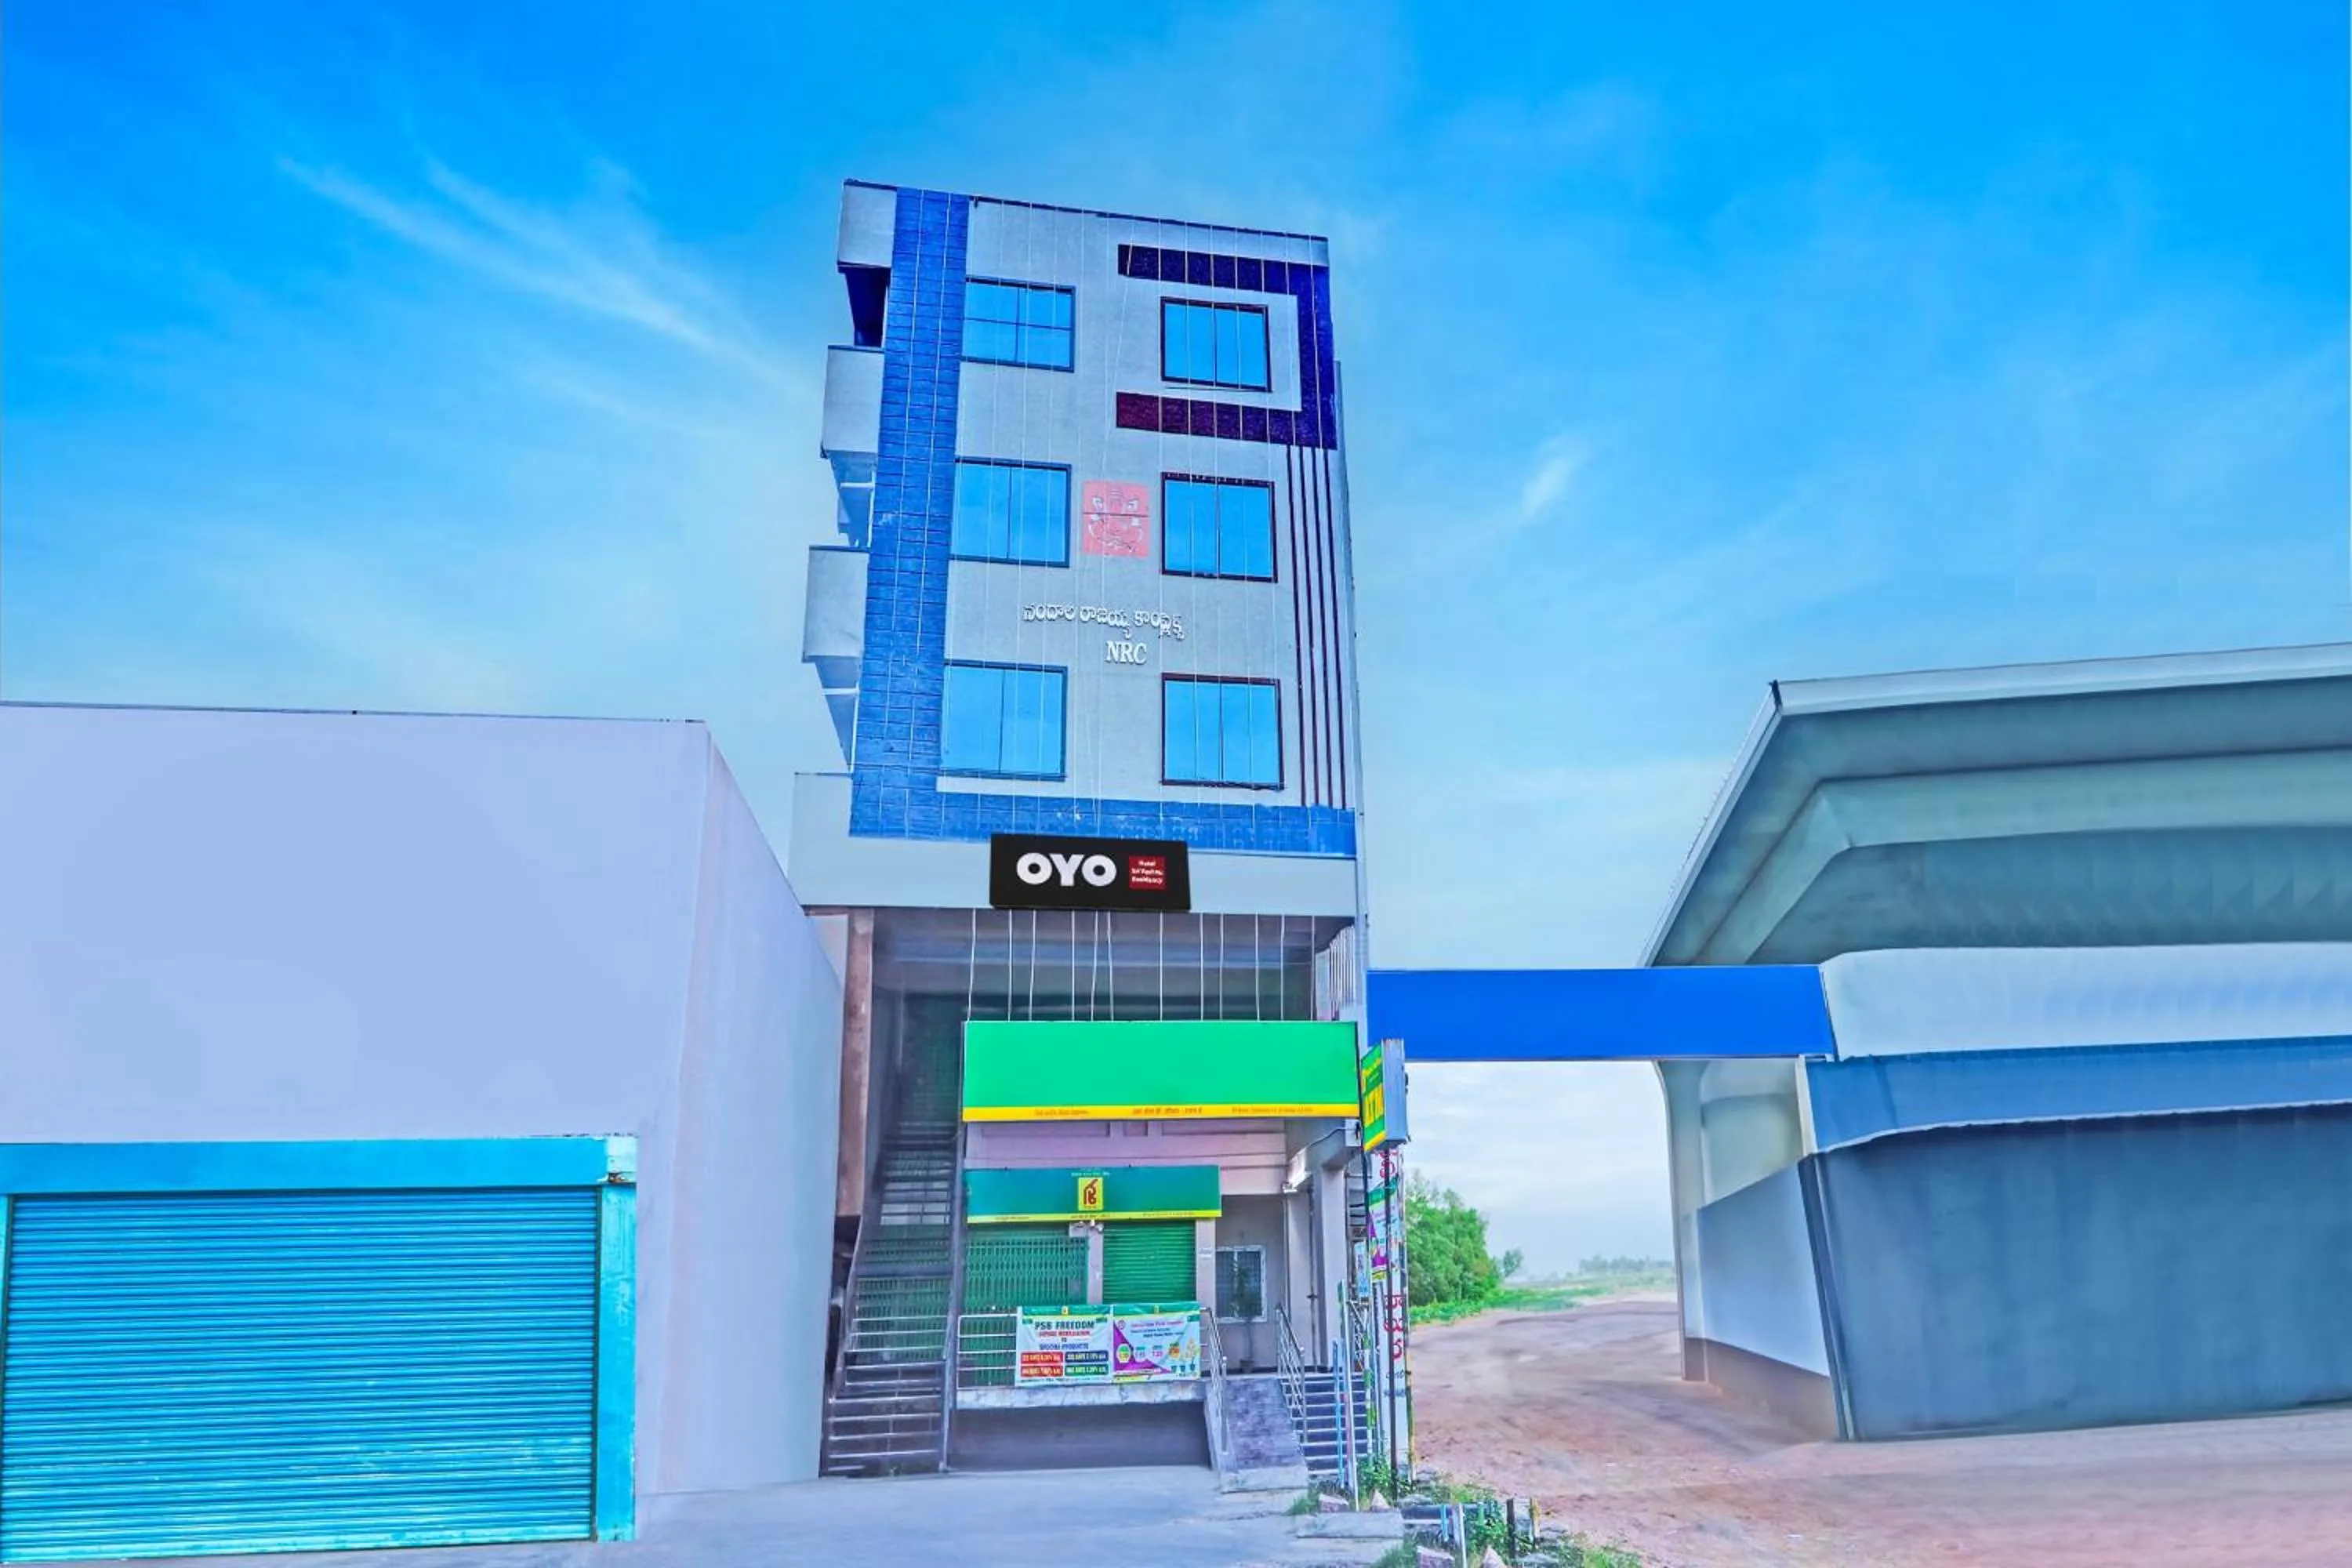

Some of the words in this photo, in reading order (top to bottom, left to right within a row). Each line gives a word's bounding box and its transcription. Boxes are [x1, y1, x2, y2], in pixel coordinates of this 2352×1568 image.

[1105, 641, 1147, 665] NRC
[1016, 852, 1117, 887] OYO
[1055, 1319, 1095, 1330] FREEDOM
